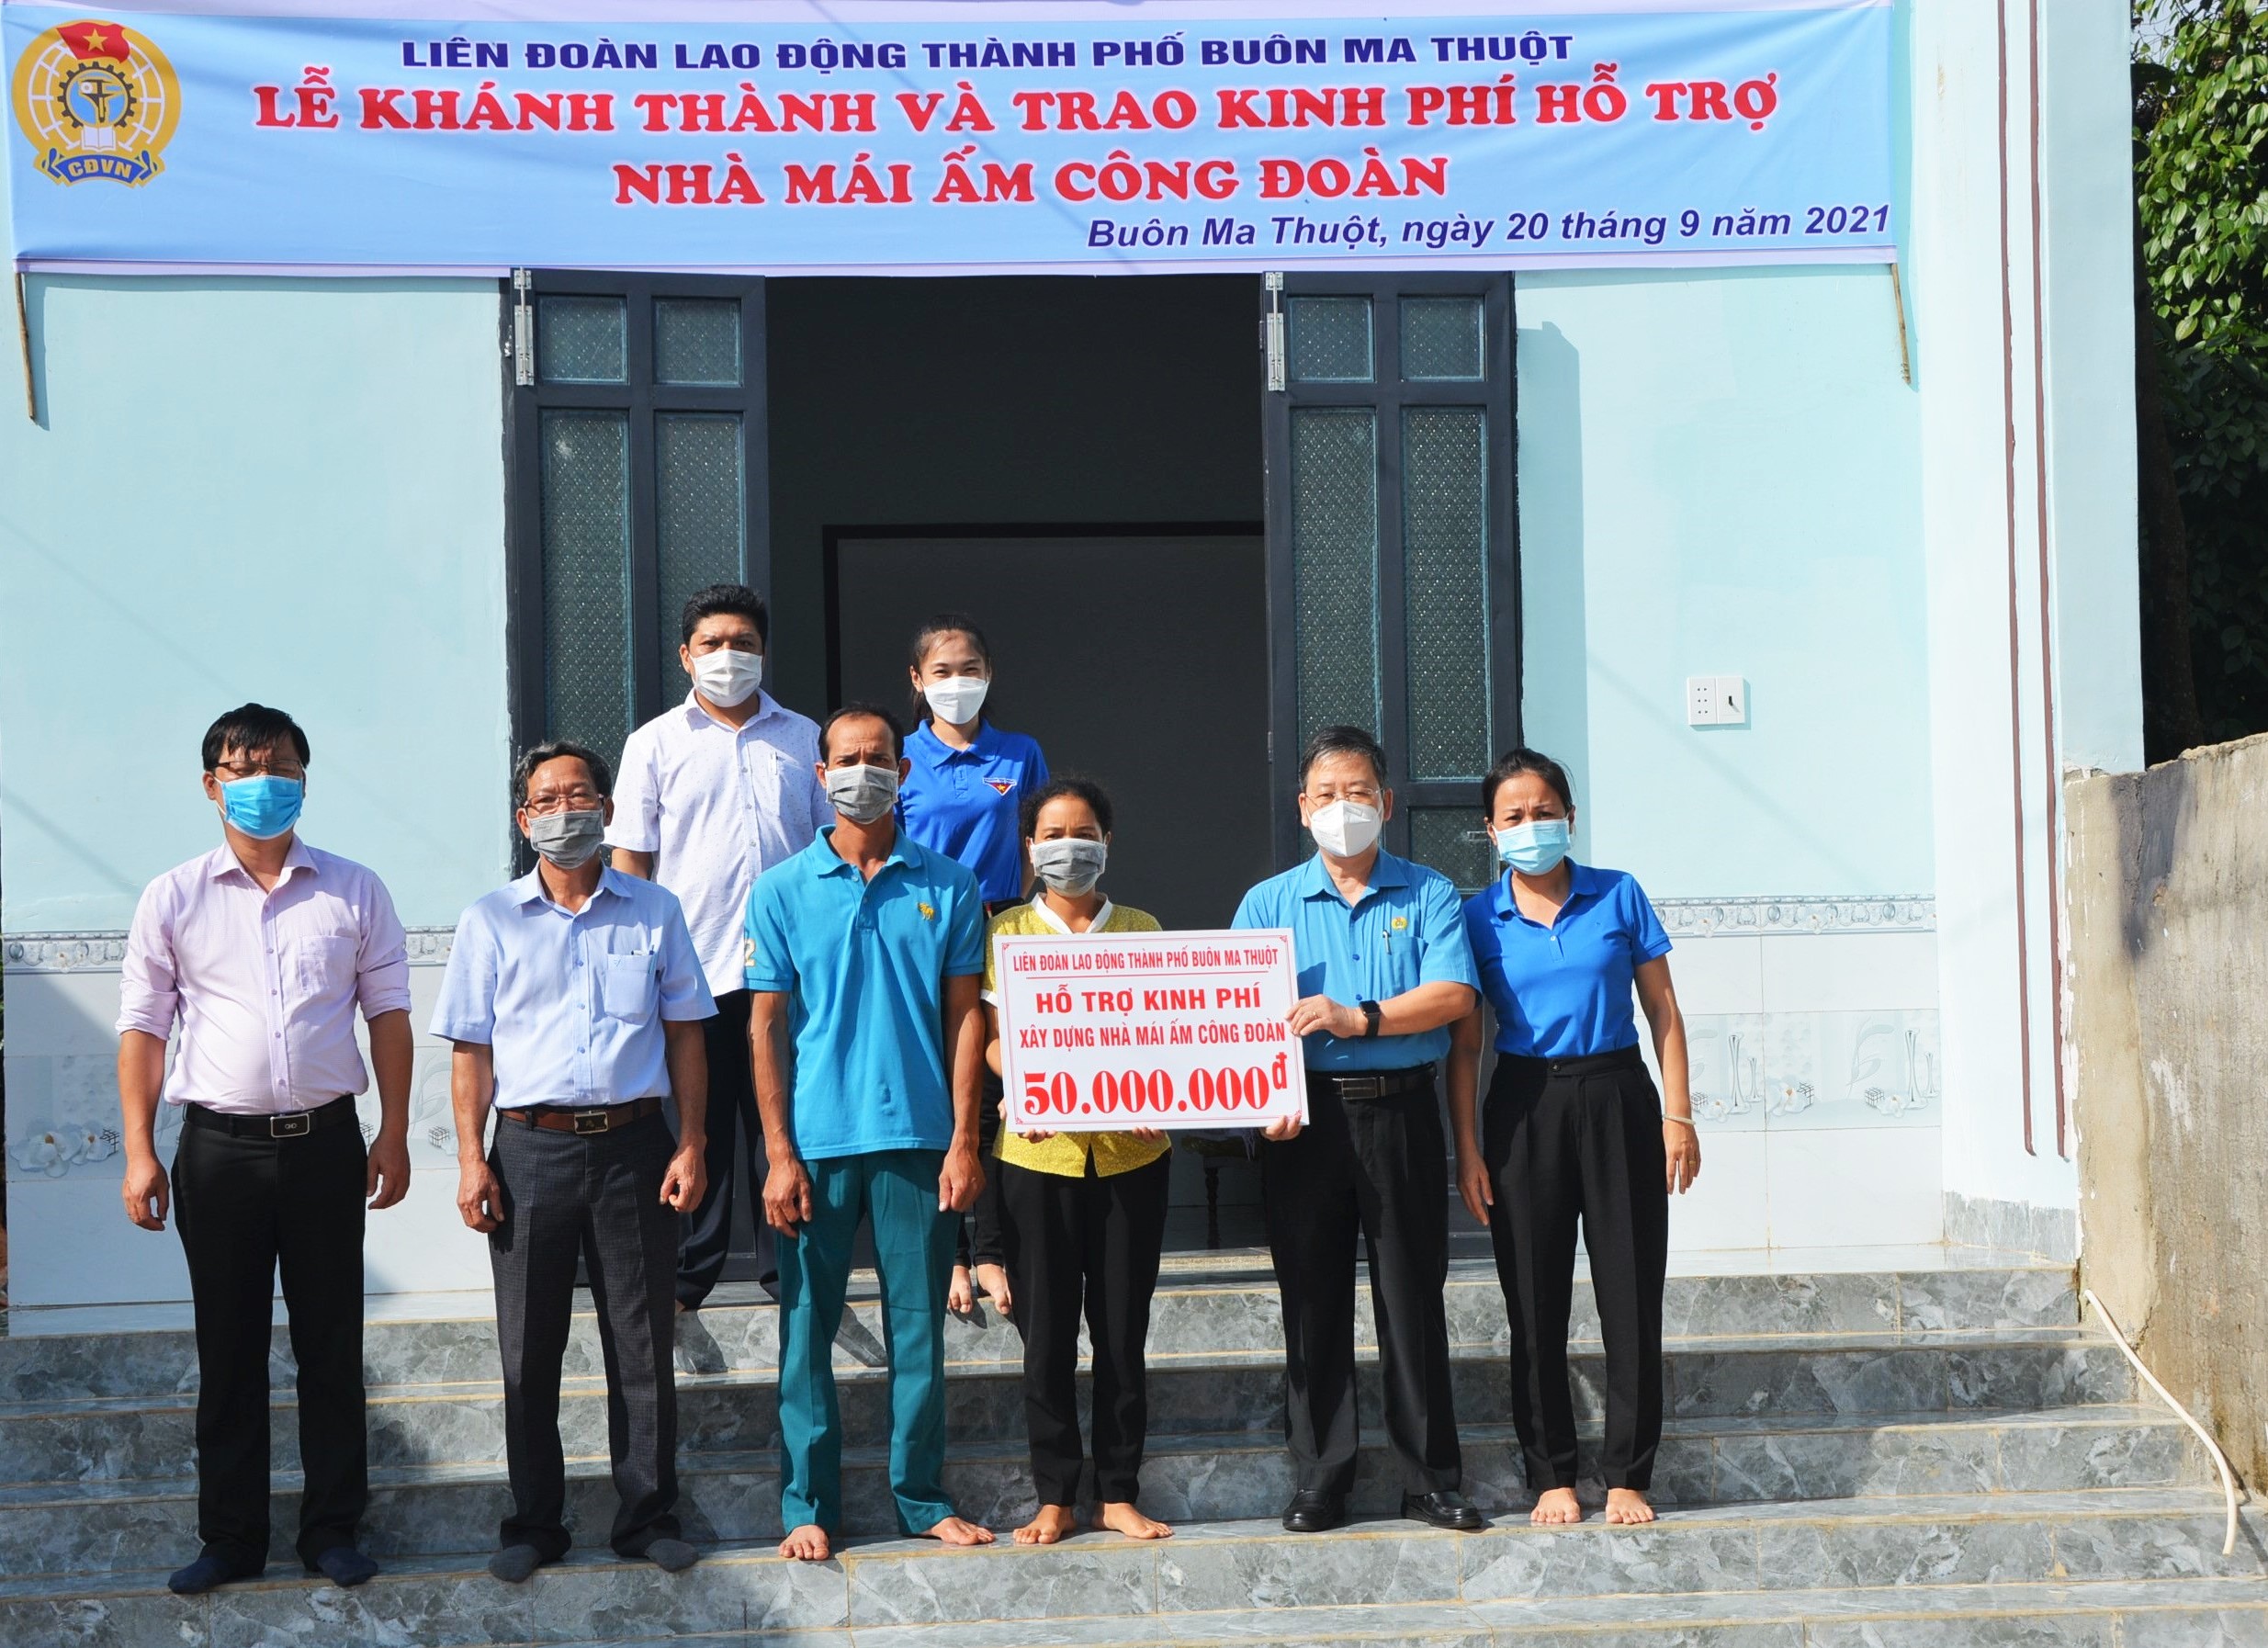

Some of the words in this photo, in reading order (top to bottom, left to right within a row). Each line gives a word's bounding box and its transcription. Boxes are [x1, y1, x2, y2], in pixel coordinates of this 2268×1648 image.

[403, 38, 508, 67] LIÊN
[525, 39, 657, 68] ĐOÀN
[676, 43, 760, 68] LAO
[777, 39, 906, 73] ĐỘNG
[922, 39, 1075, 67] THÀNH
[1093, 32, 1183, 65] PHỐ
[1202, 35, 1326, 64] BUÔN
[1345, 39, 1416, 62] MA
[1431, 31, 1573, 65] THUỘT
[255, 67, 339, 129] LỄ
[360, 82, 613, 130] KHÁNH
[636, 84, 875, 131] THÀNH
[897, 82, 994, 130] VÀ
[1014, 91, 1196, 130] TRAO
[1219, 88, 1384, 128] KINH
[1407, 74, 1516, 125] PHÍ
[1537, 63, 1626, 123] HỖ
[1646, 73, 1776, 130] TRỢ
[614, 153, 763, 204] NHÀ
[785, 153, 912, 203] MÁI
[934, 146, 1034, 202] ẤM
[1055, 151, 1238, 200] CÔNG
[1260, 148, 1448, 198] ĐOÀN
[1089, 219, 1188, 246] Buôn
[1203, 219, 1255, 244] Ma
[1272, 216, 1386, 249] Thuột,
[1403, 214, 1494, 248] ngày
[1507, 213, 1548, 239] 20
[1563, 211, 1665, 244] tháng
[1680, 210, 1699, 237] 9
[1713, 209, 1790, 236] năm
[1806, 206, 1889, 233] 2021
[1013, 952, 1036, 972] LIÊN
[1040, 949, 1069, 971] ĐOÀN
[1073, 954, 1092, 970] LAO
[1096, 949, 1124, 971] ĐỘNG
[1128, 947, 1163, 969] THÀNH
[1167, 945, 1189, 967] PHỐ
[1192, 946, 1221, 966] BUÔN
[1224, 949, 1241, 965] MA
[1243, 945, 1278, 968] THUỘT
[1036, 984, 1073, 1013] HỖ
[1081, 988, 1134, 1016] TRỢ
[1144, 988, 1206, 1010] KINH
[1216, 982, 1261, 1009] PHÍ
[1020, 1023, 1047, 1048] XÂY
[1053, 1026, 1094, 1052] DỰNG
[1100, 1022, 1131, 1046] NHÀ
[1136, 1022, 1165, 1045] MÁI
[1170, 1018, 1193, 1044] ẤM
[1198, 1021, 1239, 1044] CÔNG
[1244, 1018, 1286, 1043] ĐOÀN
